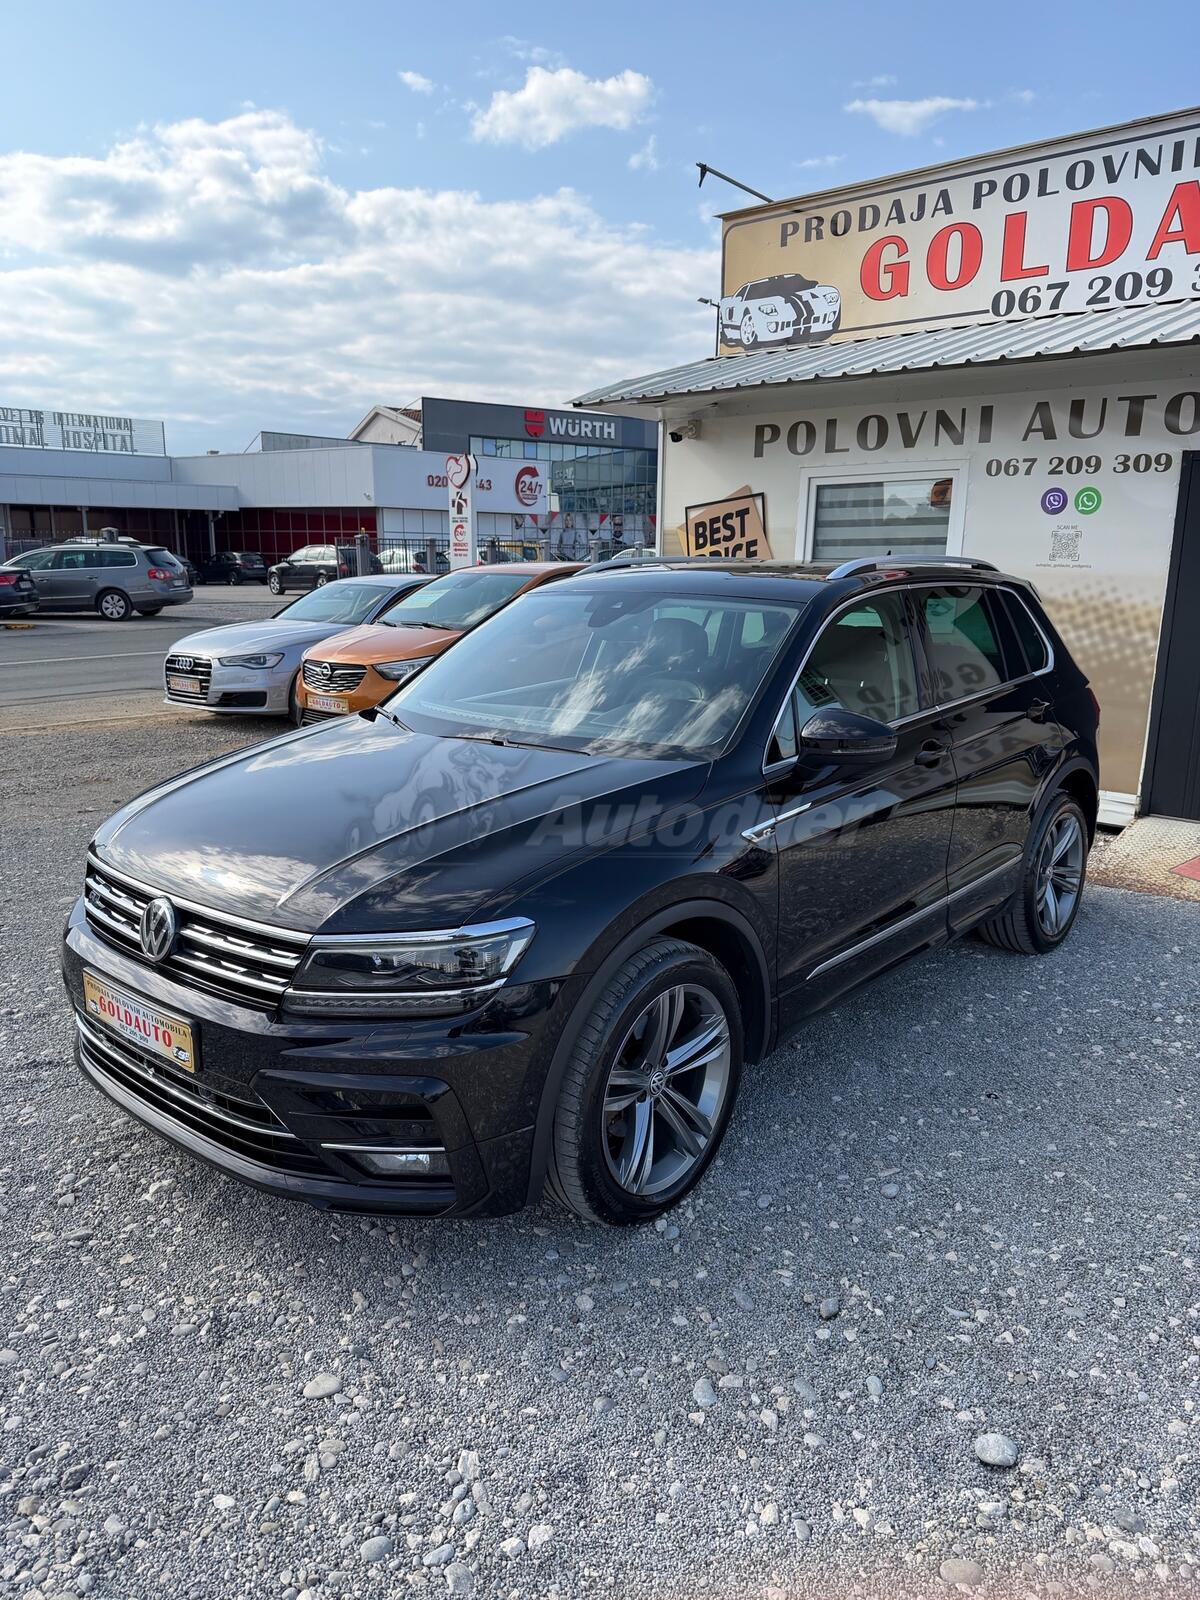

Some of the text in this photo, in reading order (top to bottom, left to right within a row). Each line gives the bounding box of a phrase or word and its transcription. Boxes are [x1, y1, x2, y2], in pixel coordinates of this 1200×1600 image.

[780, 136, 1200, 248] PRODAJA POLOVNI
[860, 180, 1200, 301] GOLDA
[991, 281, 1070, 317] 067
[1085, 267, 1173, 306] 209
[53, 411, 136, 432] INTERNATIONAL
[549, 417, 615, 440] WÜRTH
[753, 391, 1200, 458] POLOVNI AUTO
[63, 429, 138, 452] HOSPITAL
[985, 452, 1173, 477] 067 209 309
[520, 480, 543, 495] 24/7
[694, 506, 750, 551] BEST
[99, 996, 173, 1048] GOLDAUTO
[142, 1009, 188, 1038] AUTOMOBILA
